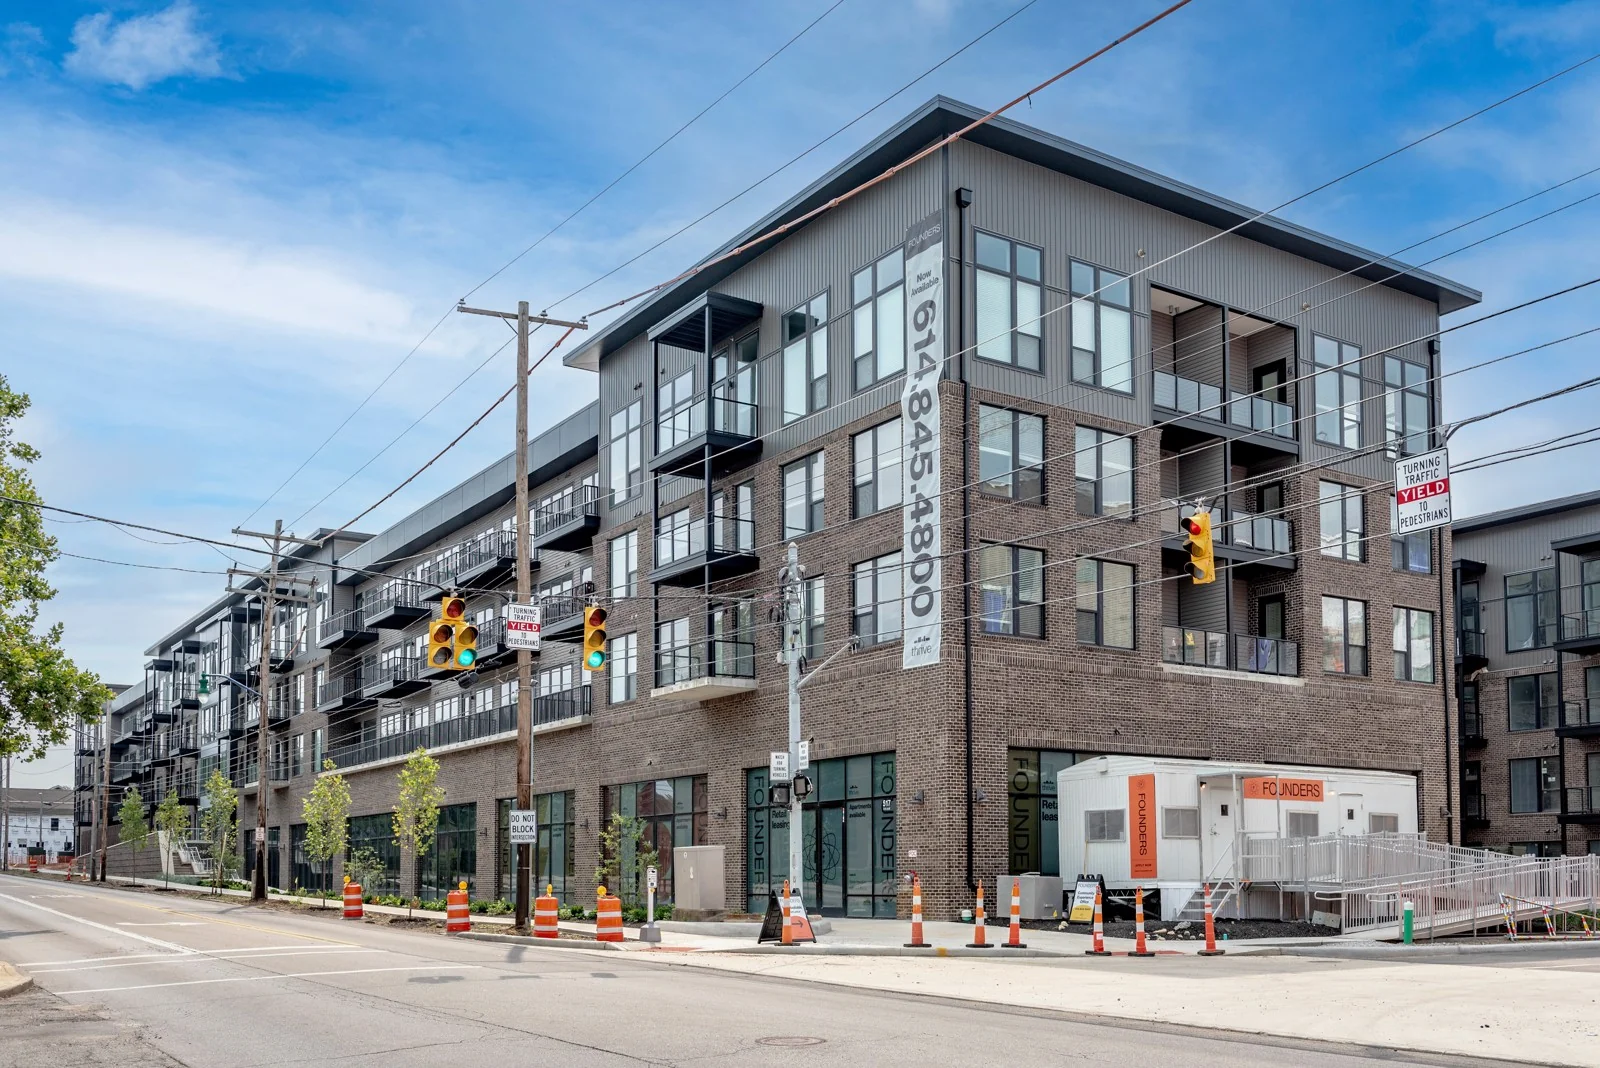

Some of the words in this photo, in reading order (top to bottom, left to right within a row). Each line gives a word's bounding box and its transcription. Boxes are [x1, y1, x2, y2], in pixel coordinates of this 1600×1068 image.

[908, 224, 941, 247] FOUNDERS
[917, 270, 932, 283] Now
[911, 277, 939, 297] Available
[908, 299, 937, 618] 614.845.4800
[1403, 456, 1440, 475] TURNING
[1405, 468, 1439, 486] TRAFFIC
[1401, 481, 1445, 502] YIELD
[1419, 501, 1428, 512] TO
[1400, 508, 1449, 528] PEDESTRIANS
[513, 607, 537, 615] TURNING
[514, 614, 536, 622] TRAFFIC
[510, 622, 538, 632] YIELD
[509, 638, 538, 647] PEDESTRIANS
[911, 643, 932, 657] thrive
[1262, 781, 1320, 797] FOUNDERS
[772, 810, 787, 818] Retail
[1013, 758, 1029, 872] FOUNDE
[512, 825, 534, 833] BLOCK
[772, 821, 790, 830] leasing
[1138, 793, 1147, 855] FOUNDERS
